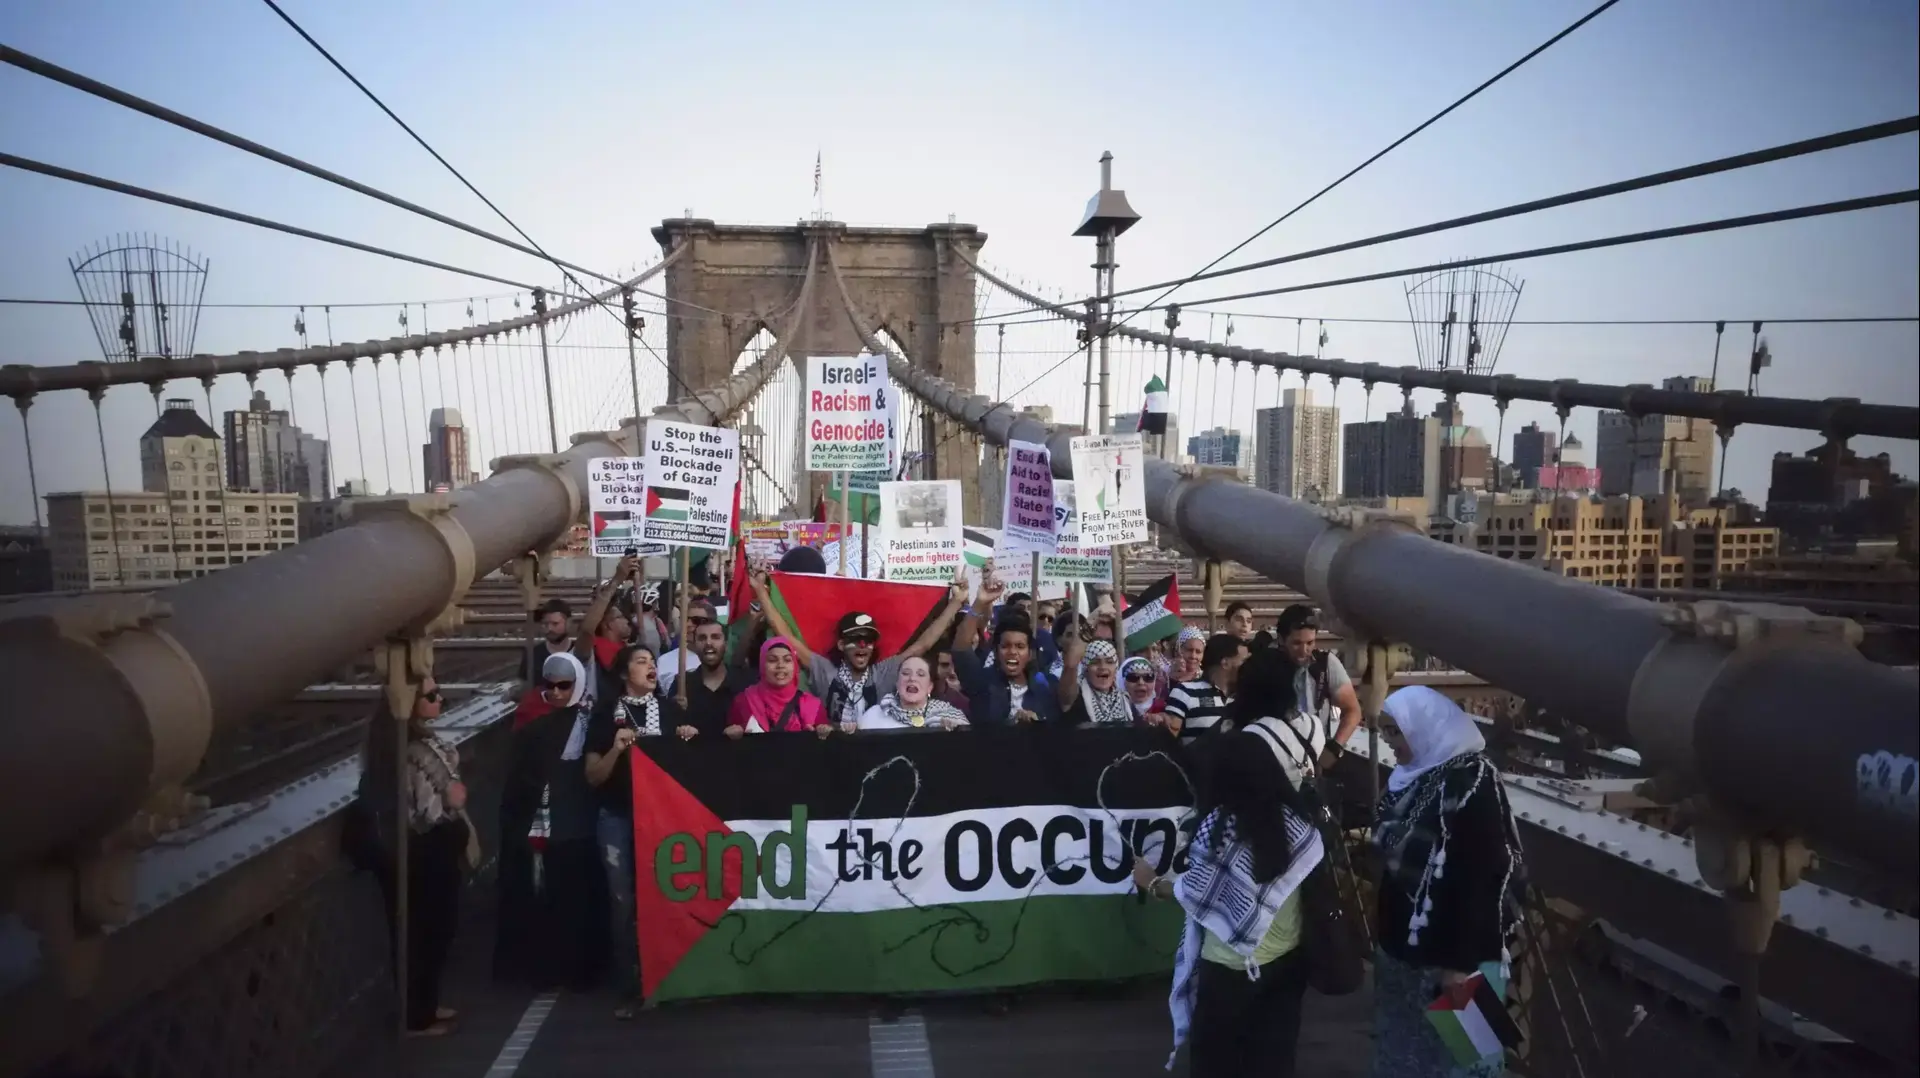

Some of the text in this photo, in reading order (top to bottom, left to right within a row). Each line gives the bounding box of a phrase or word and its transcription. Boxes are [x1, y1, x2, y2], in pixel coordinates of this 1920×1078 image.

[822, 362, 877, 385] Israel=
[811, 388, 886, 412] Racism &
[664, 427, 722, 444] Stop the
[811, 419, 885, 441] Genocide
[812, 442, 885, 453] Al-Awda NY
[828, 453, 863, 461] Palestine
[865, 453, 885, 461] Right
[1016, 450, 1034, 464] End
[602, 461, 644, 471] Stop th
[660, 455, 722, 473] Blockade
[852, 461, 886, 469] Coalition
[663, 471, 718, 486] of Gaza!
[1011, 465, 1028, 478] Aid
[1028, 468, 1040, 480] to
[601, 485, 643, 494] Blocka
[605, 496, 618, 505] of
[690, 492, 708, 506] Free
[1014, 497, 1043, 513] State
[689, 507, 728, 523] Palestine
[645, 520, 686, 532] International
[1121, 519, 1145, 529] RIVER
[1120, 530, 1136, 540] SEA
[941, 540, 955, 548] are
[887, 553, 924, 564] Freedom
[1045, 556, 1108, 568] Al-Awda NY
[891, 565, 955, 576] Al-Awda NY
[654, 804, 807, 901] end
[824, 827, 923, 882] the
